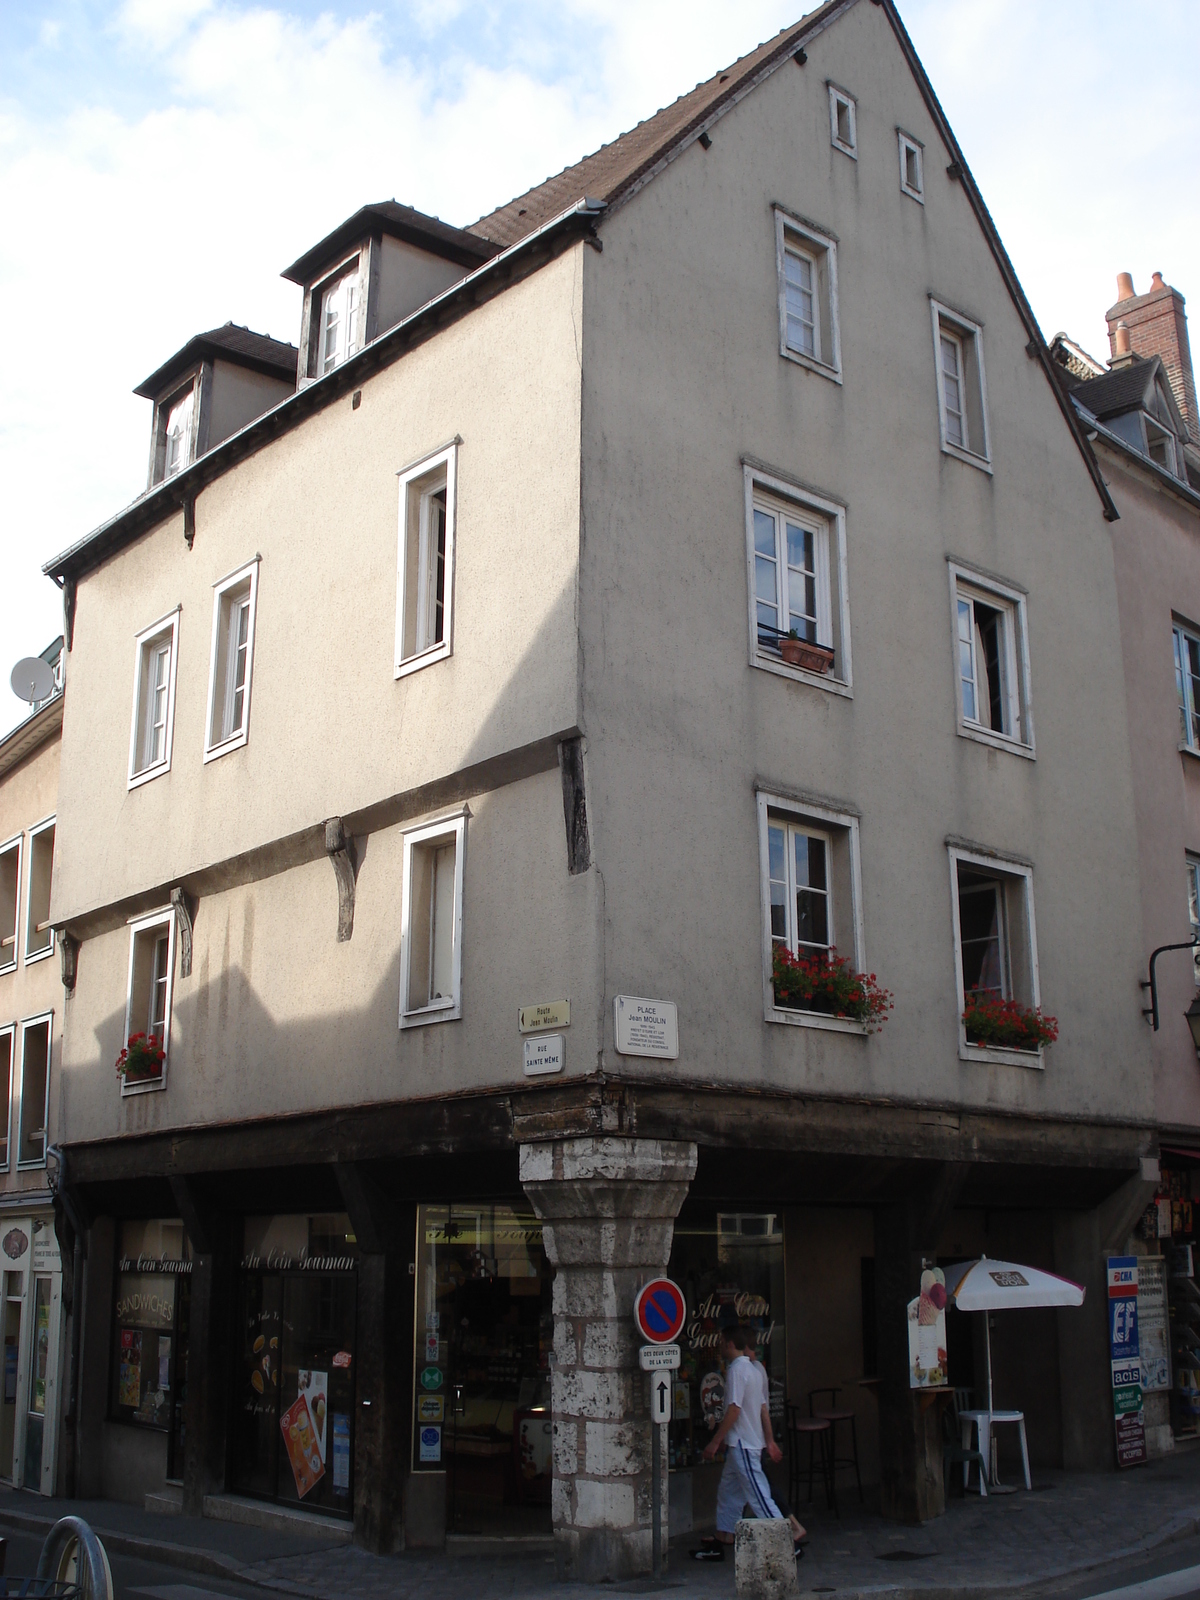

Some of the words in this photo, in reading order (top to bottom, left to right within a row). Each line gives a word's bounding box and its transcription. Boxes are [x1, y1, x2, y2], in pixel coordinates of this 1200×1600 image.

[536, 1007, 551, 1016] Route
[637, 1006, 657, 1015] PLACE
[529, 1019, 541, 1027] Jean
[543, 1016, 558, 1025] Moulin
[628, 1014, 643, 1022] Jean
[643, 1016, 667, 1025] MOULIN
[526, 1058, 543, 1067] SAINTE
[544, 1055, 559, 1064] MÊME
[119, 1253, 131, 1272] Au
[136, 1251, 156, 1272] Coin
[241, 1248, 260, 1270] Au
[267, 1246, 292, 1270] Coin
[298, 1246, 355, 1271] Gourman
[116, 1293, 173, 1321] SANDWICHES
[692, 1293, 721, 1319] Au
[734, 1291, 770, 1318] Coin
[1115, 1369, 1139, 1384] acis
[1123, 1448, 1143, 1459] ACCEPTED
